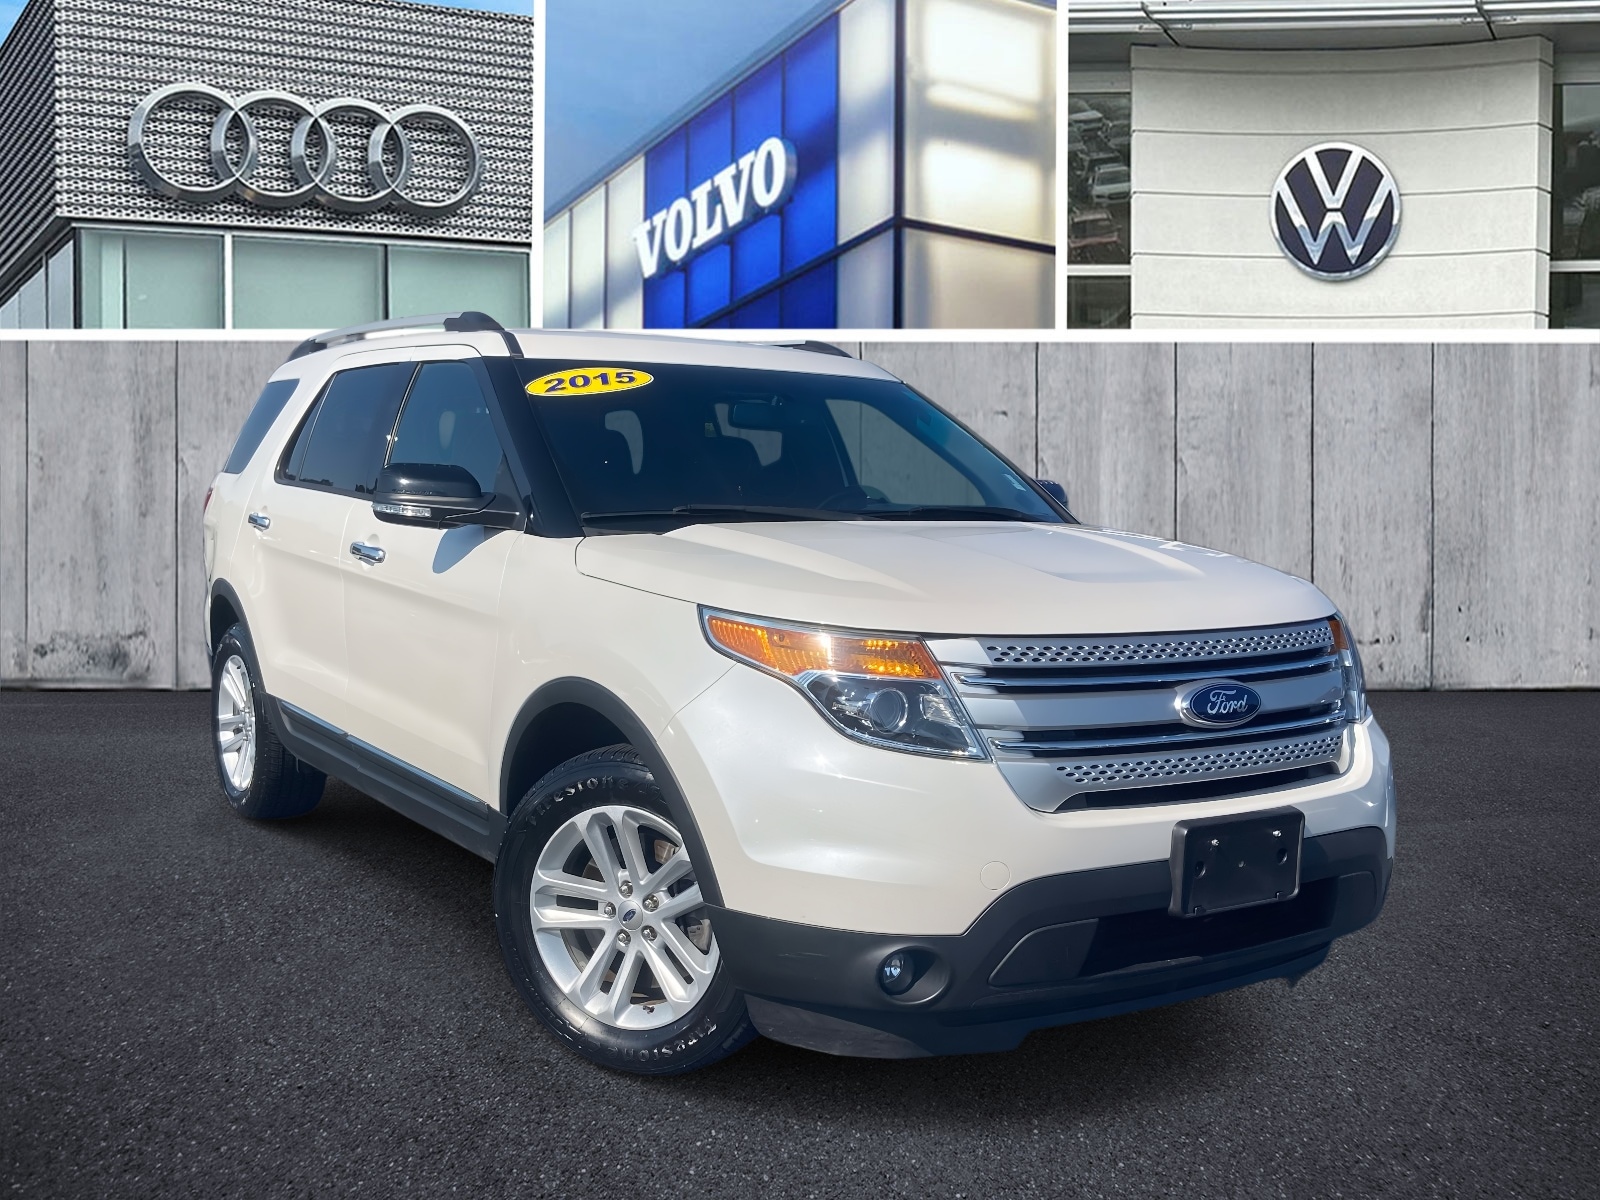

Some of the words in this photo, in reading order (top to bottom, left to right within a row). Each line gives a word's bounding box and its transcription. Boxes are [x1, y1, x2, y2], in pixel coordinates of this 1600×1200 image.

[632, 136, 786, 278] VOLVO
[1273, 147, 1395, 266] VW
[544, 371, 637, 393] 2015
[1207, 689, 1249, 715] Ford
